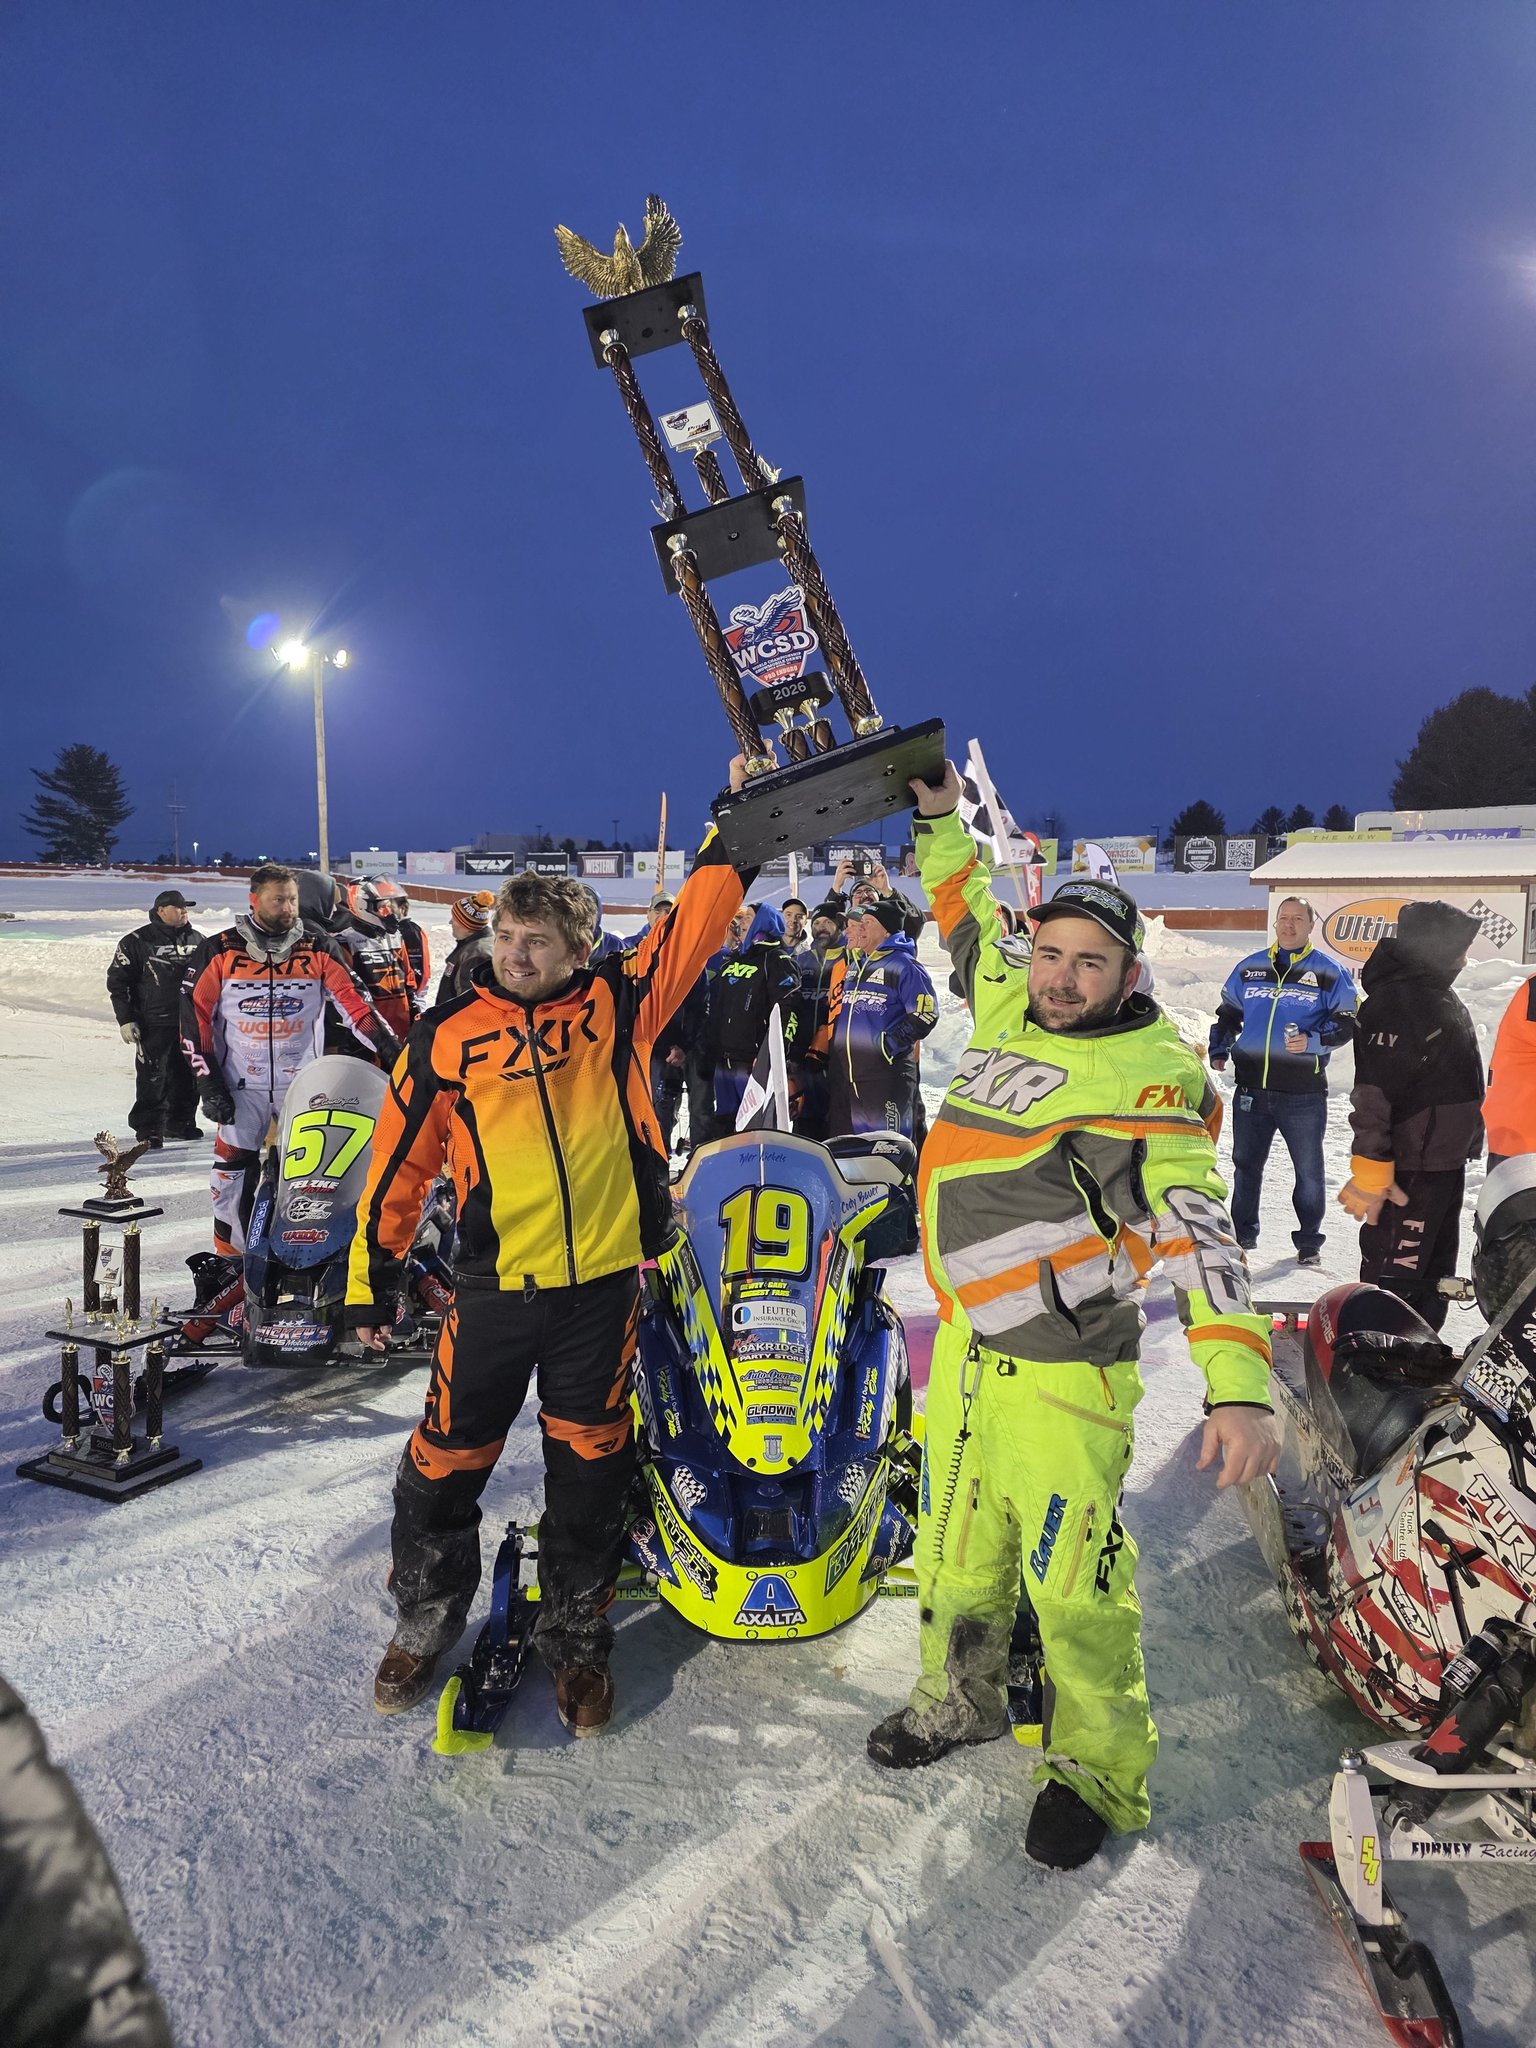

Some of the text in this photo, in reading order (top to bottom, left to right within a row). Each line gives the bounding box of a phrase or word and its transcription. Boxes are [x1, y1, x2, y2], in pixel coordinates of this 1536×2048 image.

[731, 631, 810, 669] WCSD
[764, 672, 776, 681] PRO
[773, 681, 807, 700] 2026
[1347, 833, 1377, 841] NEW
[1454, 832, 1508, 842] United
[477, 859, 513, 870] FLY
[537, 864, 566, 872] RAM
[585, 858, 616, 873] WESTERN
[464, 903, 476, 916] FOR
[229, 955, 312, 975] FXR
[721, 962, 759, 979] FXR
[916, 993, 934, 1013] 19
[1244, 987, 1319, 1003] BAUER
[238, 1019, 305, 1040] woody's
[239, 1040, 302, 1050] POLARIS
[459, 999, 598, 1079] FXR
[948, 1047, 1069, 1116] FXR
[283, 1109, 377, 1182] 57
[288, 1179, 340, 1191] FELZKE
[841, 1198, 857, 1214] Cody
[248, 1200, 269, 1249] POLARIS
[282, 1229, 329, 1244] woody's
[718, 1184, 814, 1282] 19
[1393, 1220, 1425, 1271] FLY
[753, 1315, 786, 1323] INSURANCE
[762, 1305, 797, 1318] IEUTER
[1318, 1297, 1335, 1345] POLARIS
[255, 1325, 332, 1340] MICKEY'S
[255, 1336, 328, 1348] SLEDS Motorsports
[738, 1342, 804, 1355] OAKRIDGE
[740, 1353, 805, 1362] PARTY STORE
[1471, 1368, 1513, 1413] MIRA
[747, 1405, 797, 1416] GLADWIN
[857, 1406, 866, 1424] Memory
[674, 1412, 683, 1435] Dearest
[1407, 1510, 1415, 1535] Truck
[1030, 1493, 1068, 1584] BAUER
[1400, 1511, 1408, 1560] Centre Ltd.
[736, 1611, 805, 1626] AXALTA
[1479, 1842, 1536, 1863] Racing
